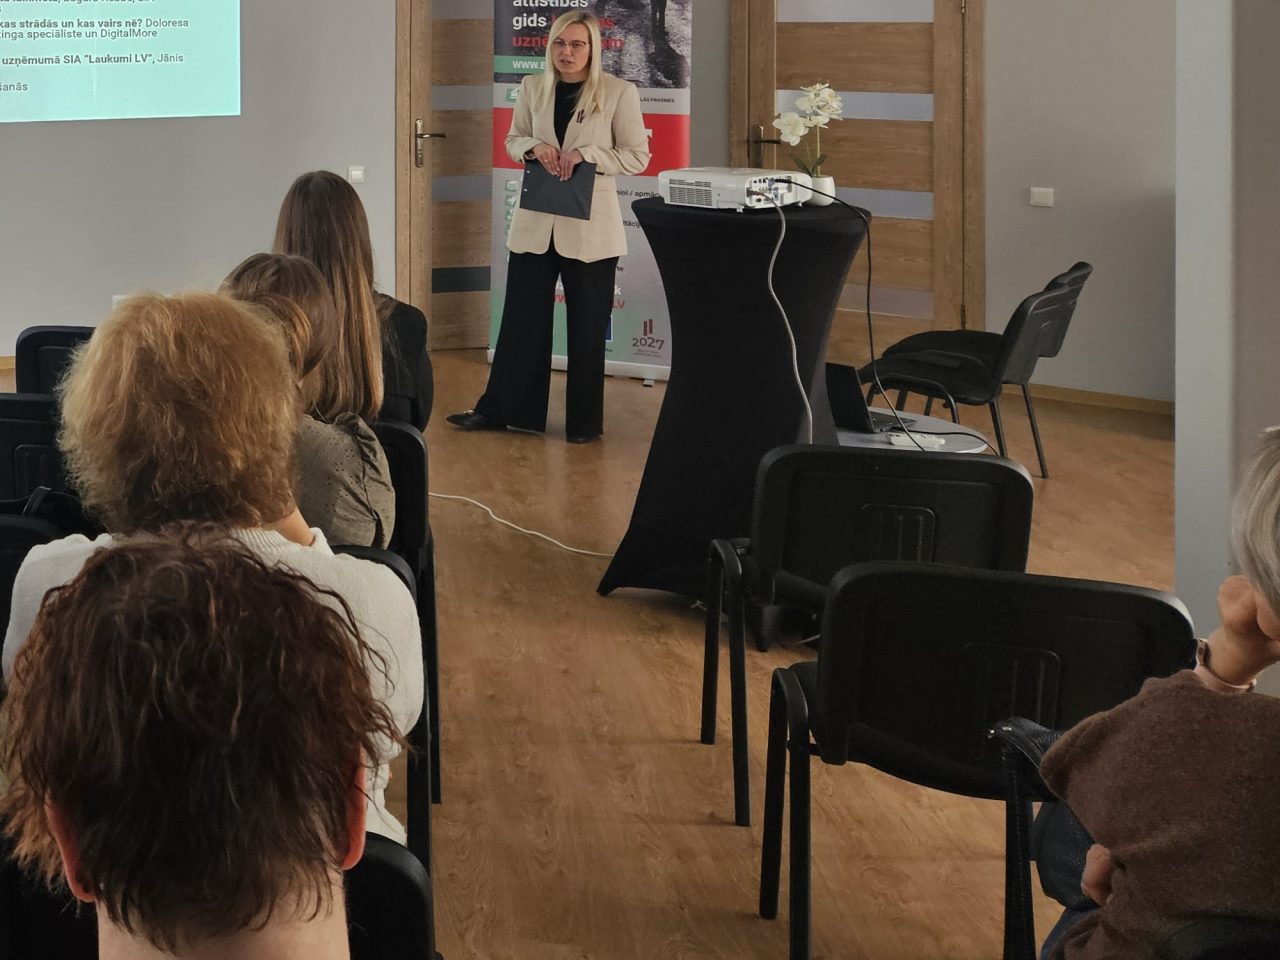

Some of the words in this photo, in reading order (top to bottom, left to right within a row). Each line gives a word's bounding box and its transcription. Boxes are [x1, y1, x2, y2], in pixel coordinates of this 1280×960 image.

[20, 19, 59, 28] strādās
[77, 19, 95, 28] kas
[98, 19, 122, 28] vairs
[125, 19, 143, 28] nē?
[146, 18, 189, 27] Doloresa
[513, 13, 547, 30] gids
[27, 29, 82, 40] speciāliste
[86, 30, 98, 38] un
[101, 28, 158, 39] DigitalMore
[2, 55, 61, 67] uzņēmumā
[64, 55, 81, 64] SIA
[158, 54, 184, 63] Jānis
[632, 337, 665, 350] 2027
